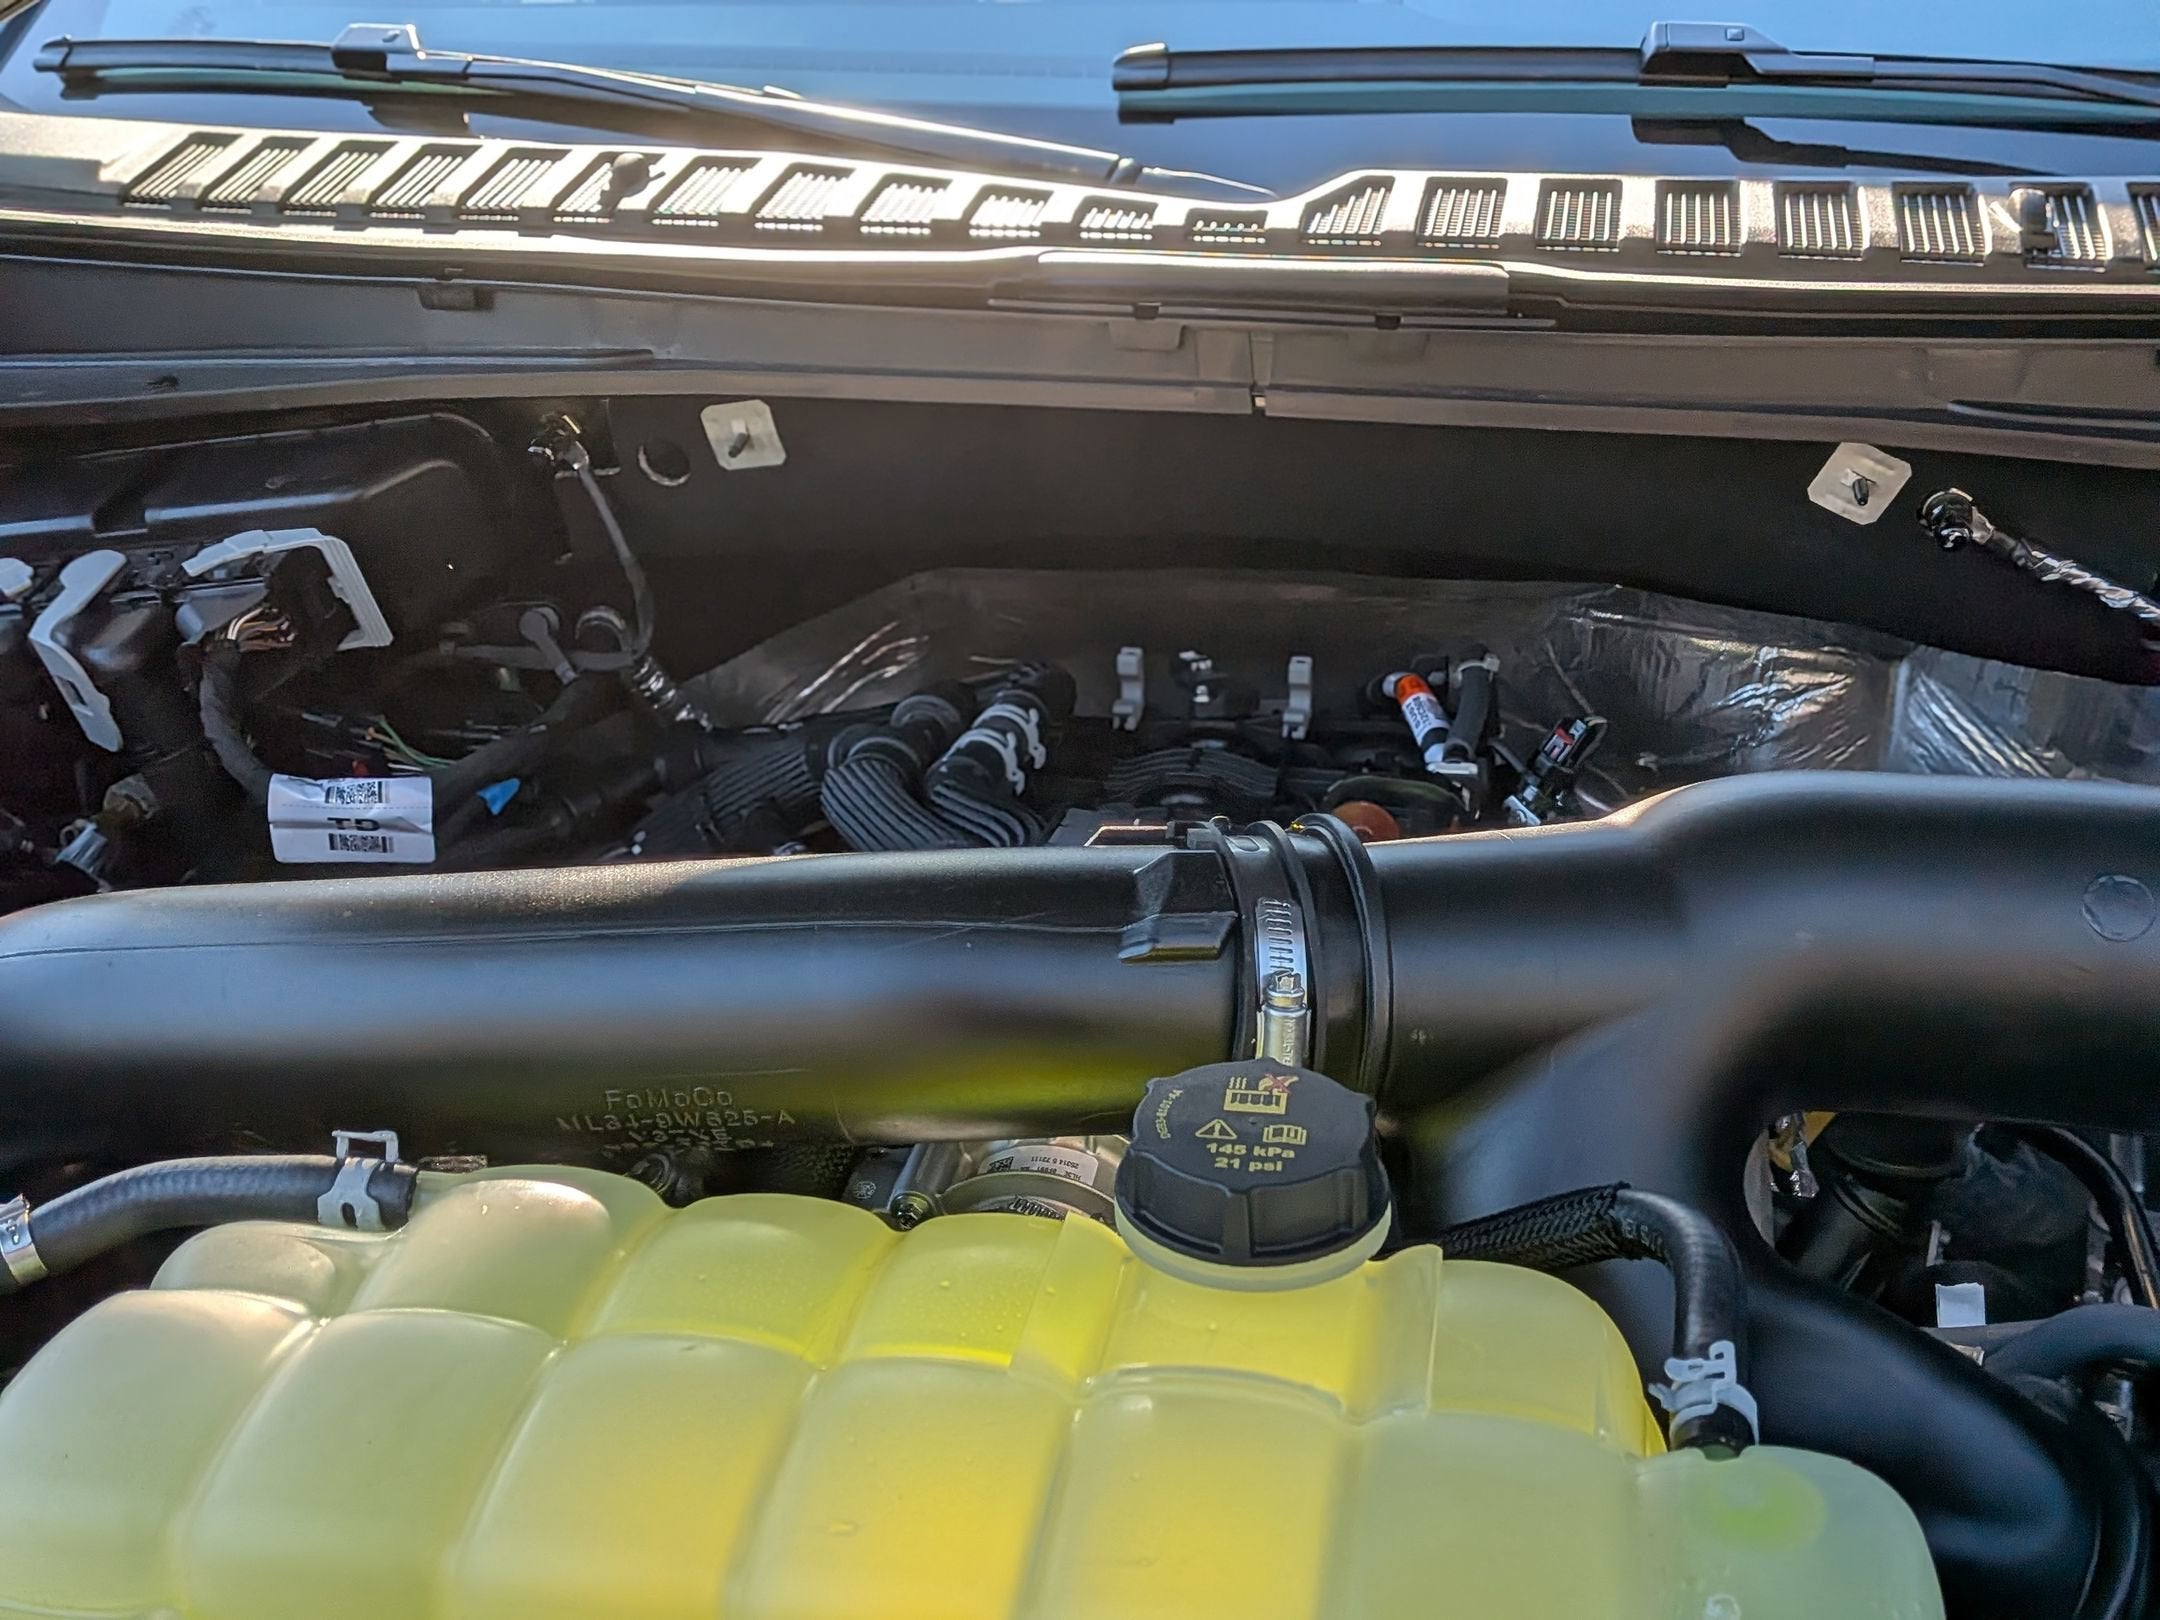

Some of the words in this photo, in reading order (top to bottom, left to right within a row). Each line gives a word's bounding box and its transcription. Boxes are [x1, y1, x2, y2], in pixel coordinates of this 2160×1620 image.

[605, 1086, 733, 1110] FoMoCo
[1206, 1143, 1247, 1155] 145
[1253, 1144, 1296, 1158] kPa
[1214, 1157, 1241, 1169] 21
[1248, 1160, 1283, 1172] psi
